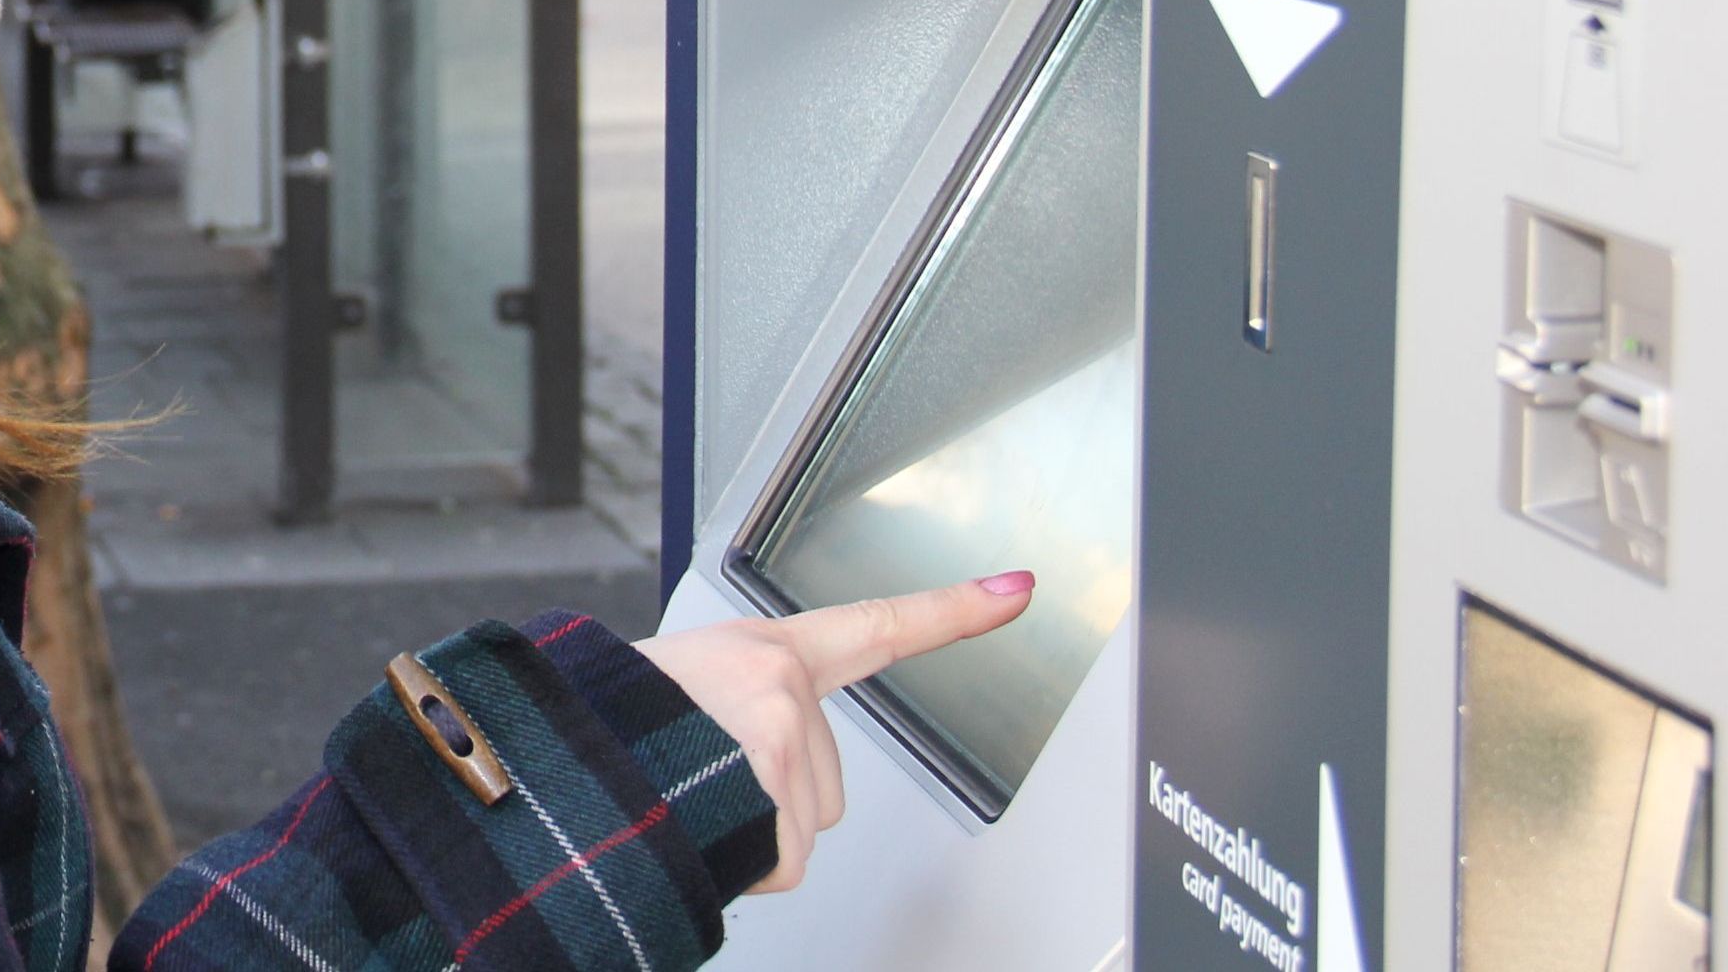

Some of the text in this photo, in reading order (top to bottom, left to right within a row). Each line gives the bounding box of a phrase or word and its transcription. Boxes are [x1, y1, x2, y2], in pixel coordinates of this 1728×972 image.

[1149, 760, 1304, 939] Kartenzahlung
[1182, 862, 1303, 972] card payment
